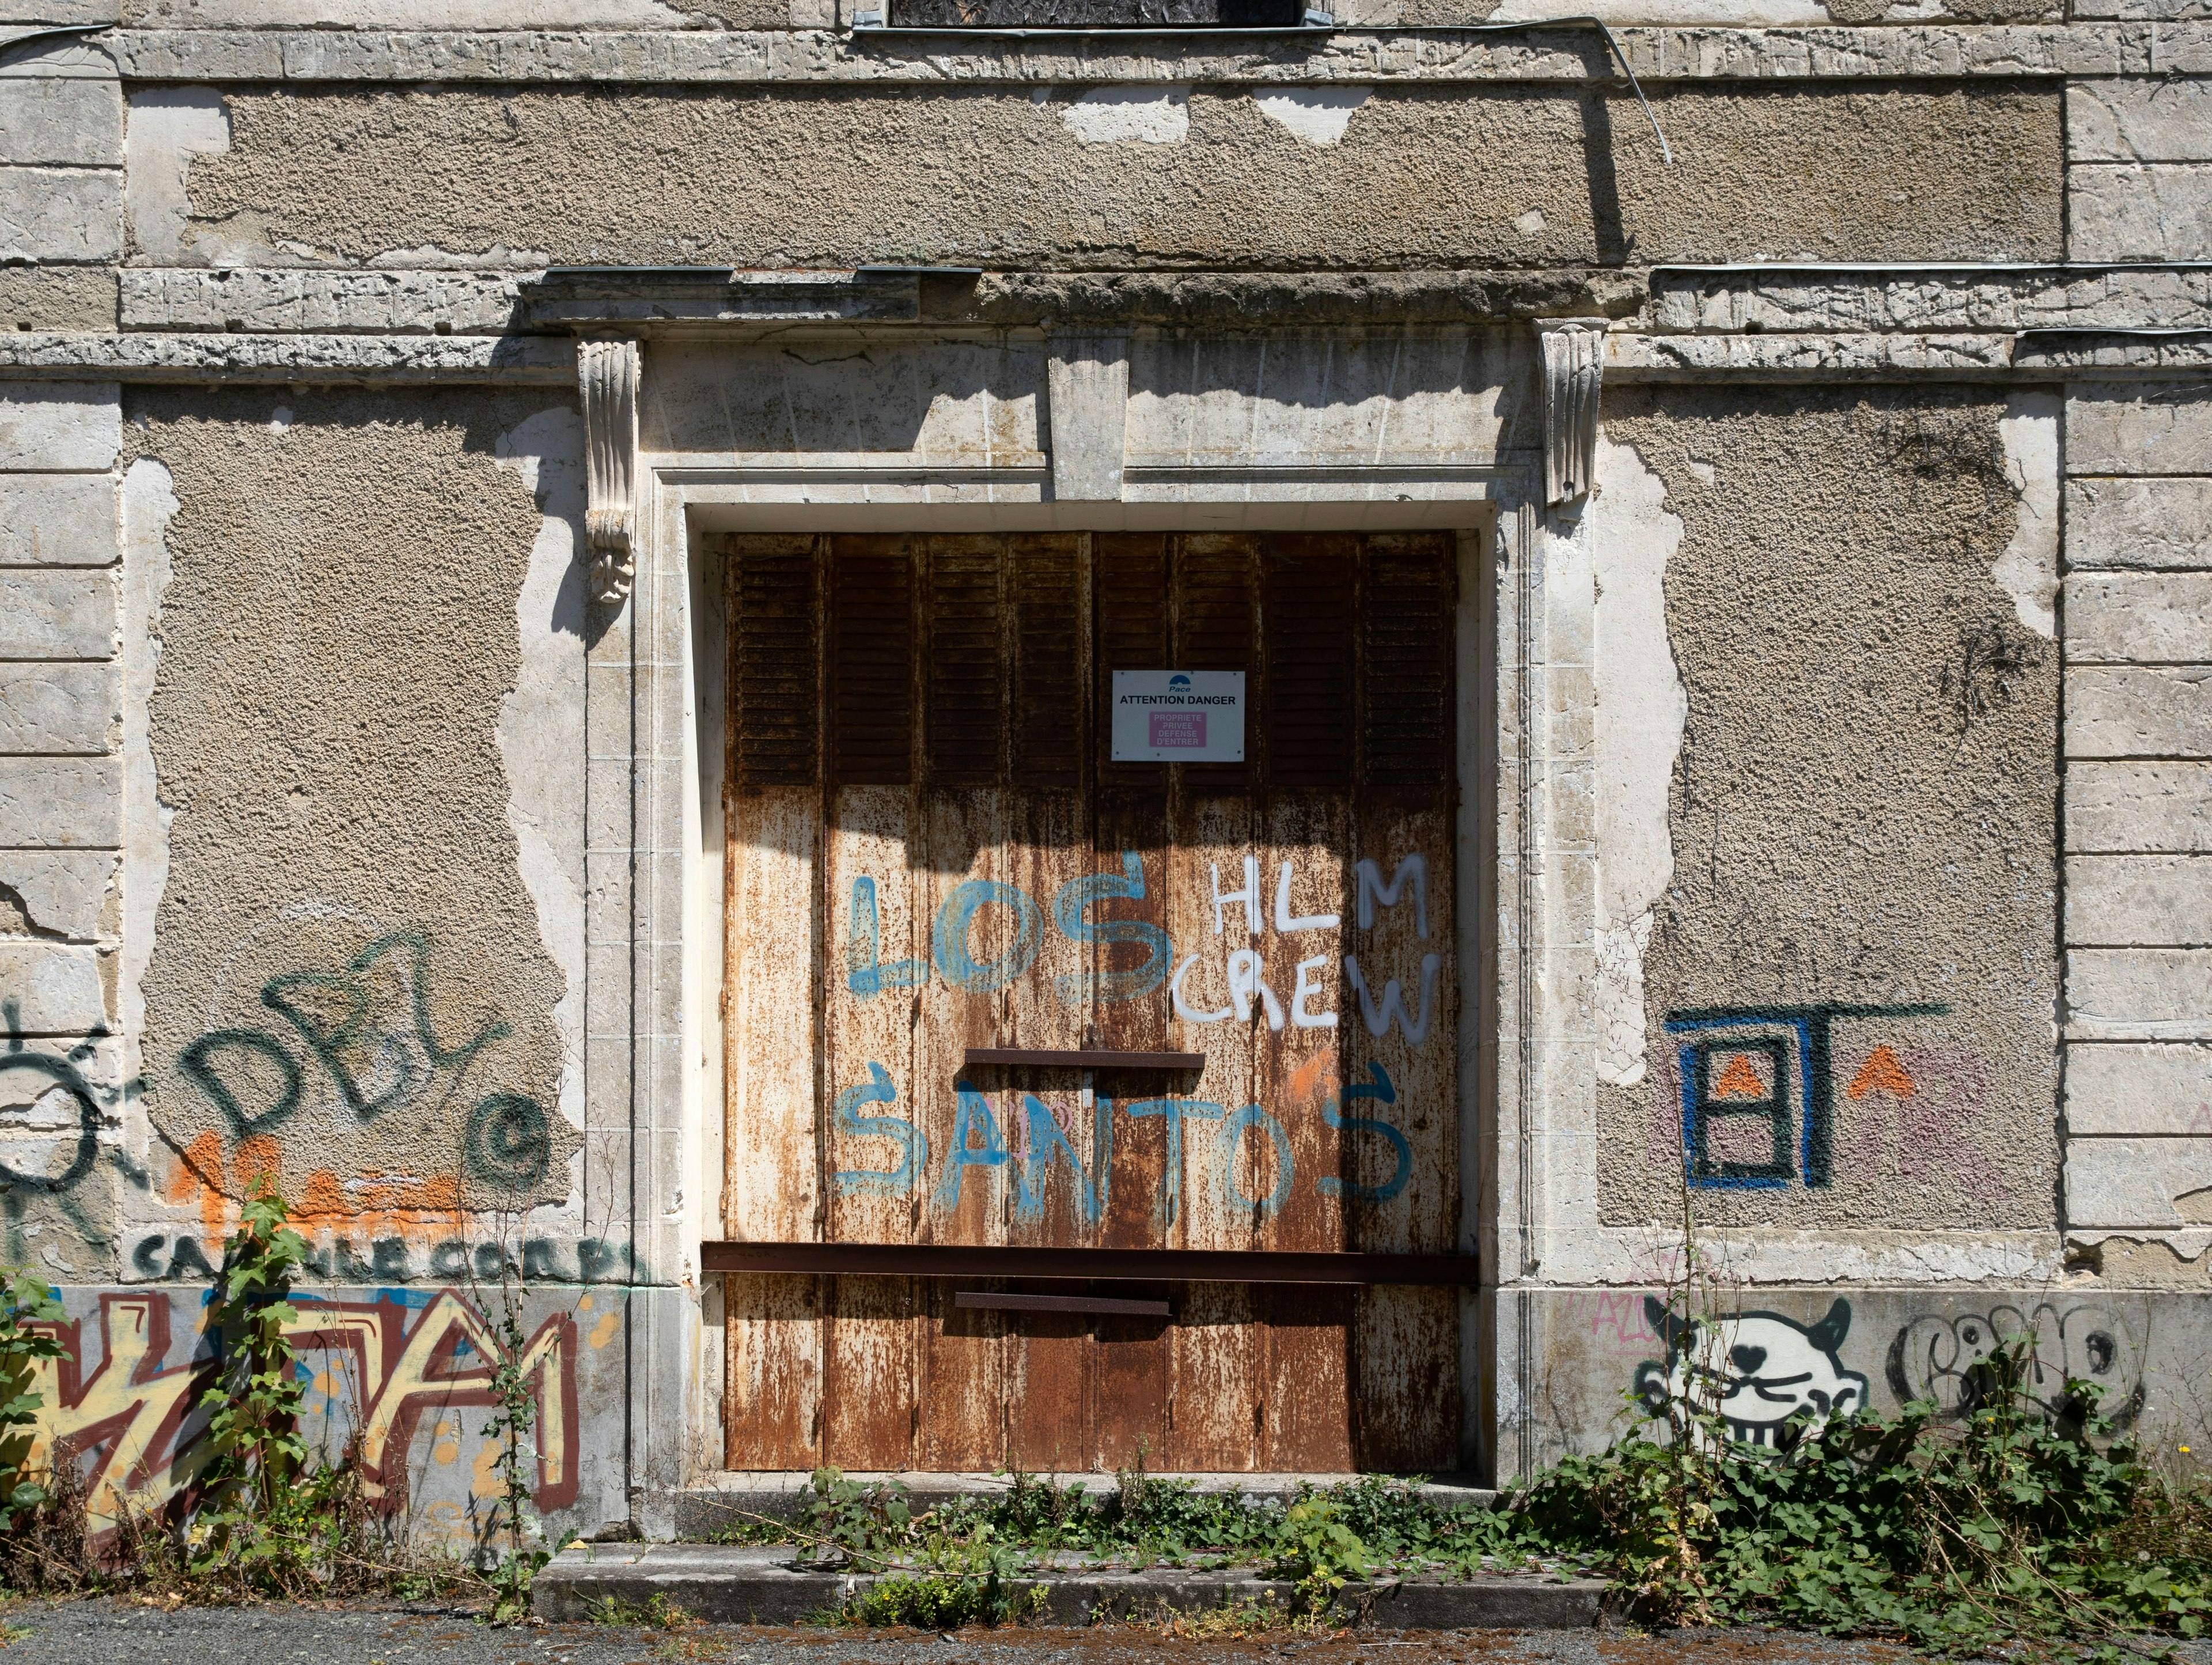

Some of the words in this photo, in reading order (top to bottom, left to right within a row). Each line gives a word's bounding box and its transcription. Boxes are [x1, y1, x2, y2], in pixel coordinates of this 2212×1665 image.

[1120, 695, 1184, 705] ATTENTION
[1188, 695, 1236, 705] DANGER
[848, 849, 1174, 1004] LOS
[1209, 853, 1429, 940] HLM
[1169, 948, 1442, 1045] CREW
[831, 1060, 1413, 1226] SANTOS
